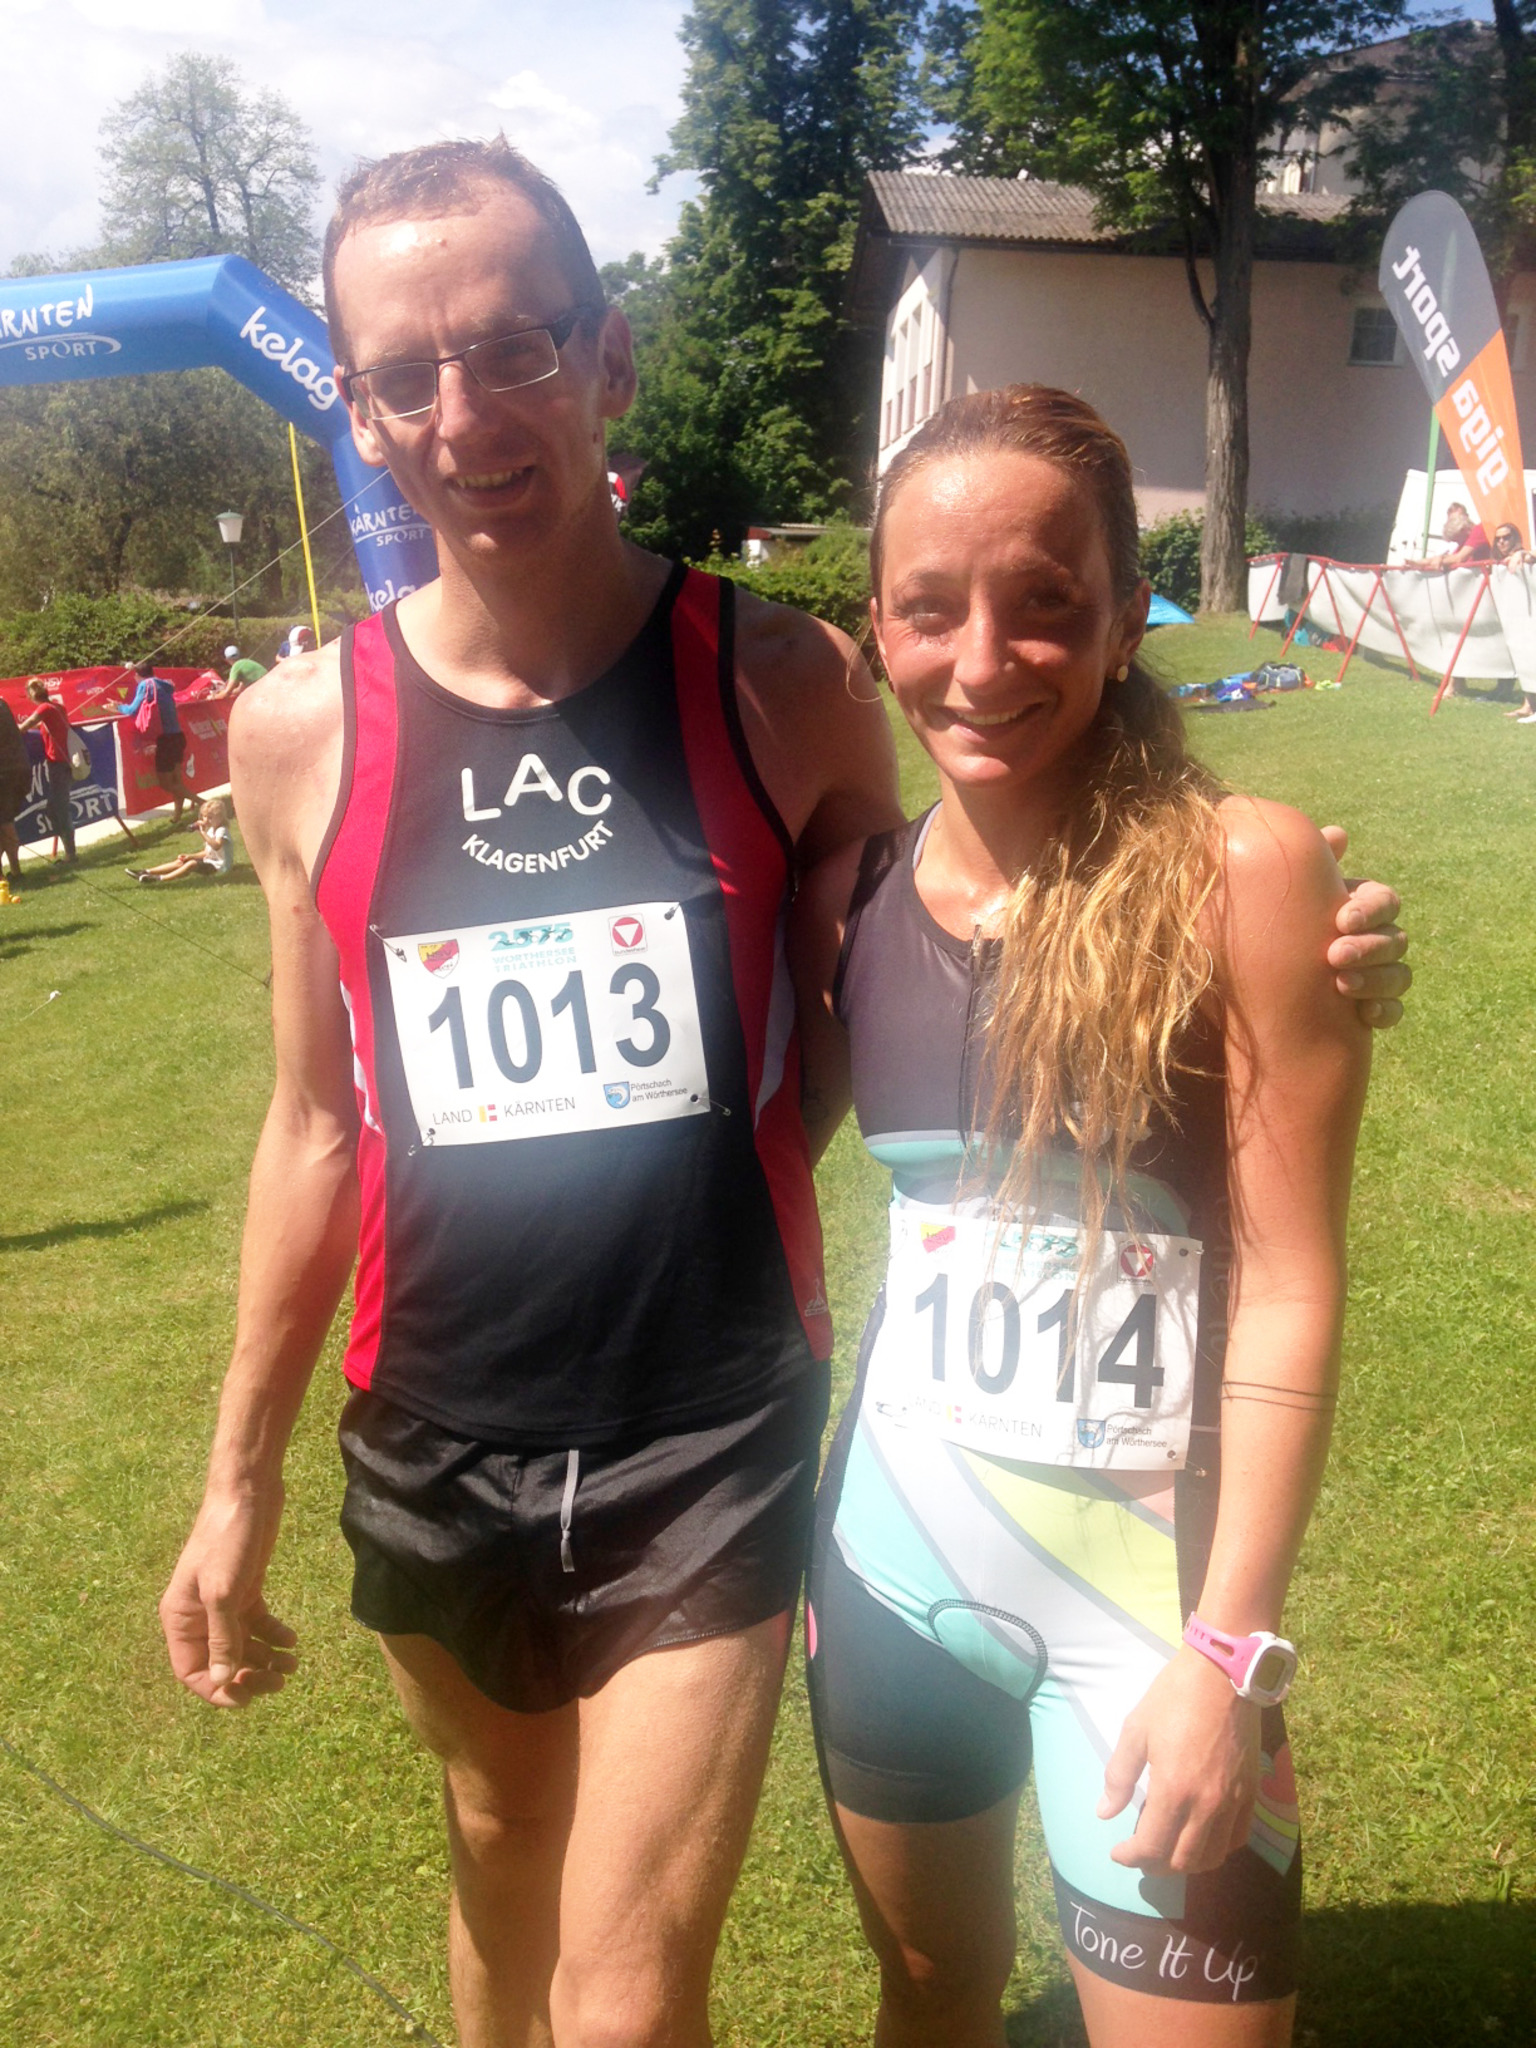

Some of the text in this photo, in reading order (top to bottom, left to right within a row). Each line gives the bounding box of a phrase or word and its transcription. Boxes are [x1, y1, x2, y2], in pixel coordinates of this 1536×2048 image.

[0, 283, 94, 338] RNTEN
[24, 341, 97, 361] SPORT
[240, 305, 340, 411] kelag
[376, 529, 426, 547] SPORT
[460, 753, 613, 822] LAC
[461, 820, 614, 874] KLAGENFURT
[494, 955, 577, 973] TRIATHLON
[427, 962, 672, 1090] 1013
[630, 1077, 672, 1092] Pörtschach
[631, 1087, 688, 1103] am Wörthersee
[432, 1097, 577, 1126] LAND KÄRNTEN
[914, 1272, 1166, 1410] 1014
[1106, 1423, 1152, 1436] Pörtschach
[1121, 1437, 1168, 1448] Wörthersee
[1070, 1901, 1259, 2002] Tone It Up
